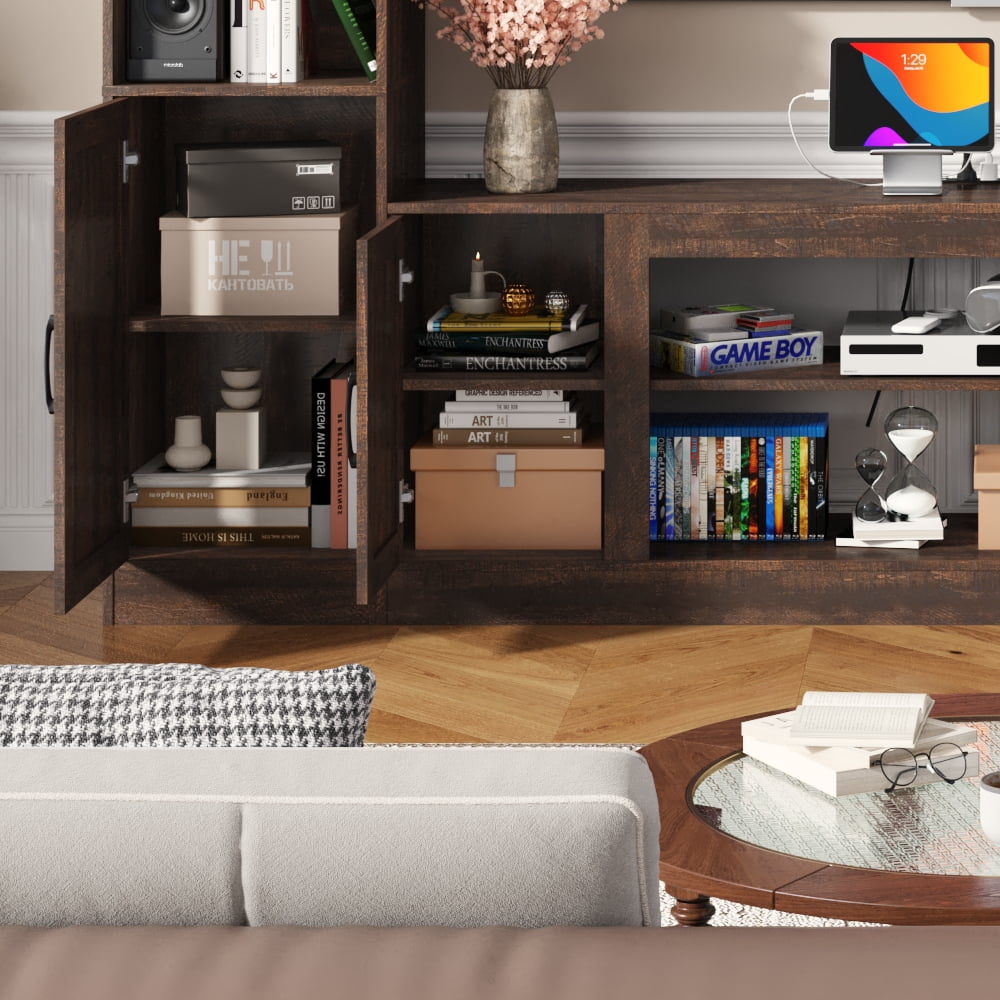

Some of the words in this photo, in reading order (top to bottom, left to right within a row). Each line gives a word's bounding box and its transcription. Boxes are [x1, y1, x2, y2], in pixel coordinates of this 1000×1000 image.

[901, 54, 927, 65] 1:29
[208, 240, 250, 275] НЕ
[208, 279, 293, 291] КАНТОВАТЬ
[485, 336, 544, 348] ENCHANTRESS
[710, 340, 771, 366] GAME
[775, 336, 818, 358] BOY
[466, 357, 567, 370] ENCHANTRESS
[472, 416, 493, 426] ART
[468, 432, 491, 442] ART
[149, 492, 184, 500] Kingdom
[247, 488, 288, 501] England
[183, 533, 214, 541] HOME
[217, 533, 227, 541] IS
[230, 533, 254, 541] THIS
